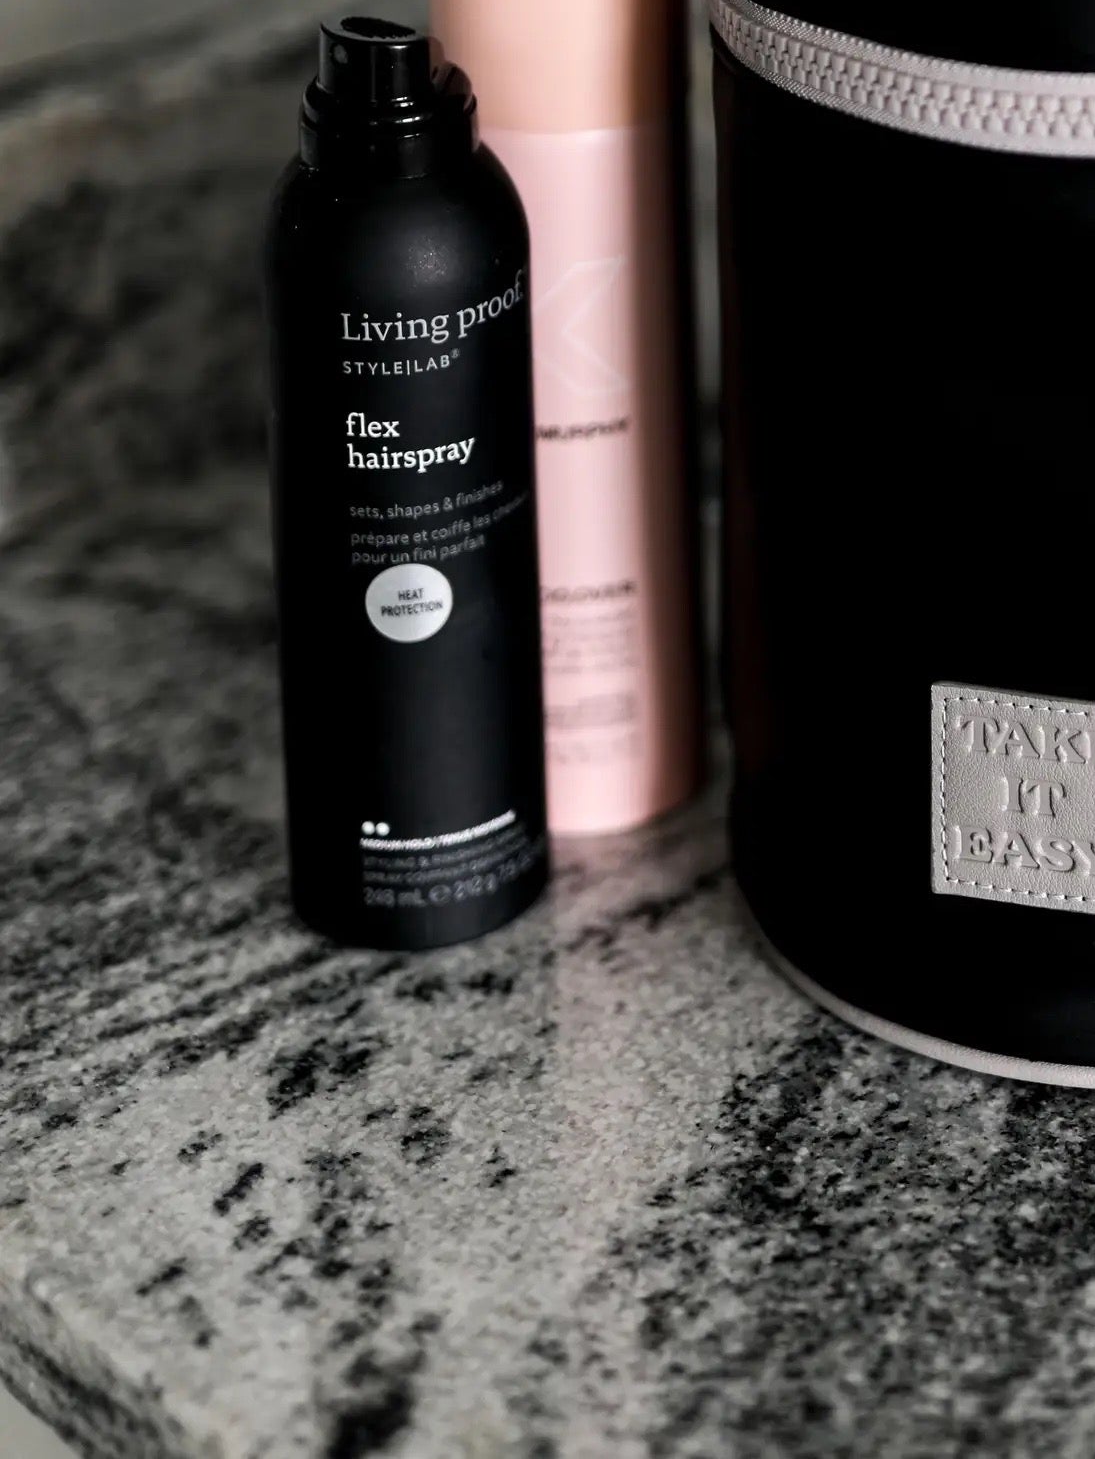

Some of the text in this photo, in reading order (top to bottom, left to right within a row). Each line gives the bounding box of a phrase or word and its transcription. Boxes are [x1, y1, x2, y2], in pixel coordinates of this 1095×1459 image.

[341, 312, 449, 343] Living
[346, 412, 400, 438] flex
[347, 437, 475, 473] hairspray
[350, 505, 384, 520] sets,
[387, 501, 440, 520] shapes
[443, 497, 453, 512] &
[456, 480, 504, 507] finishes
[413, 529, 428, 542] et
[431, 519, 471, 540] coiffe
[352, 550, 387, 564] pour
[391, 549, 409, 563] un
[413, 545, 437, 561] fini
[398, 587, 423, 601] HEAT
[381, 600, 443, 617] PROTECTION
[1000, 776, 1068, 818] IT
